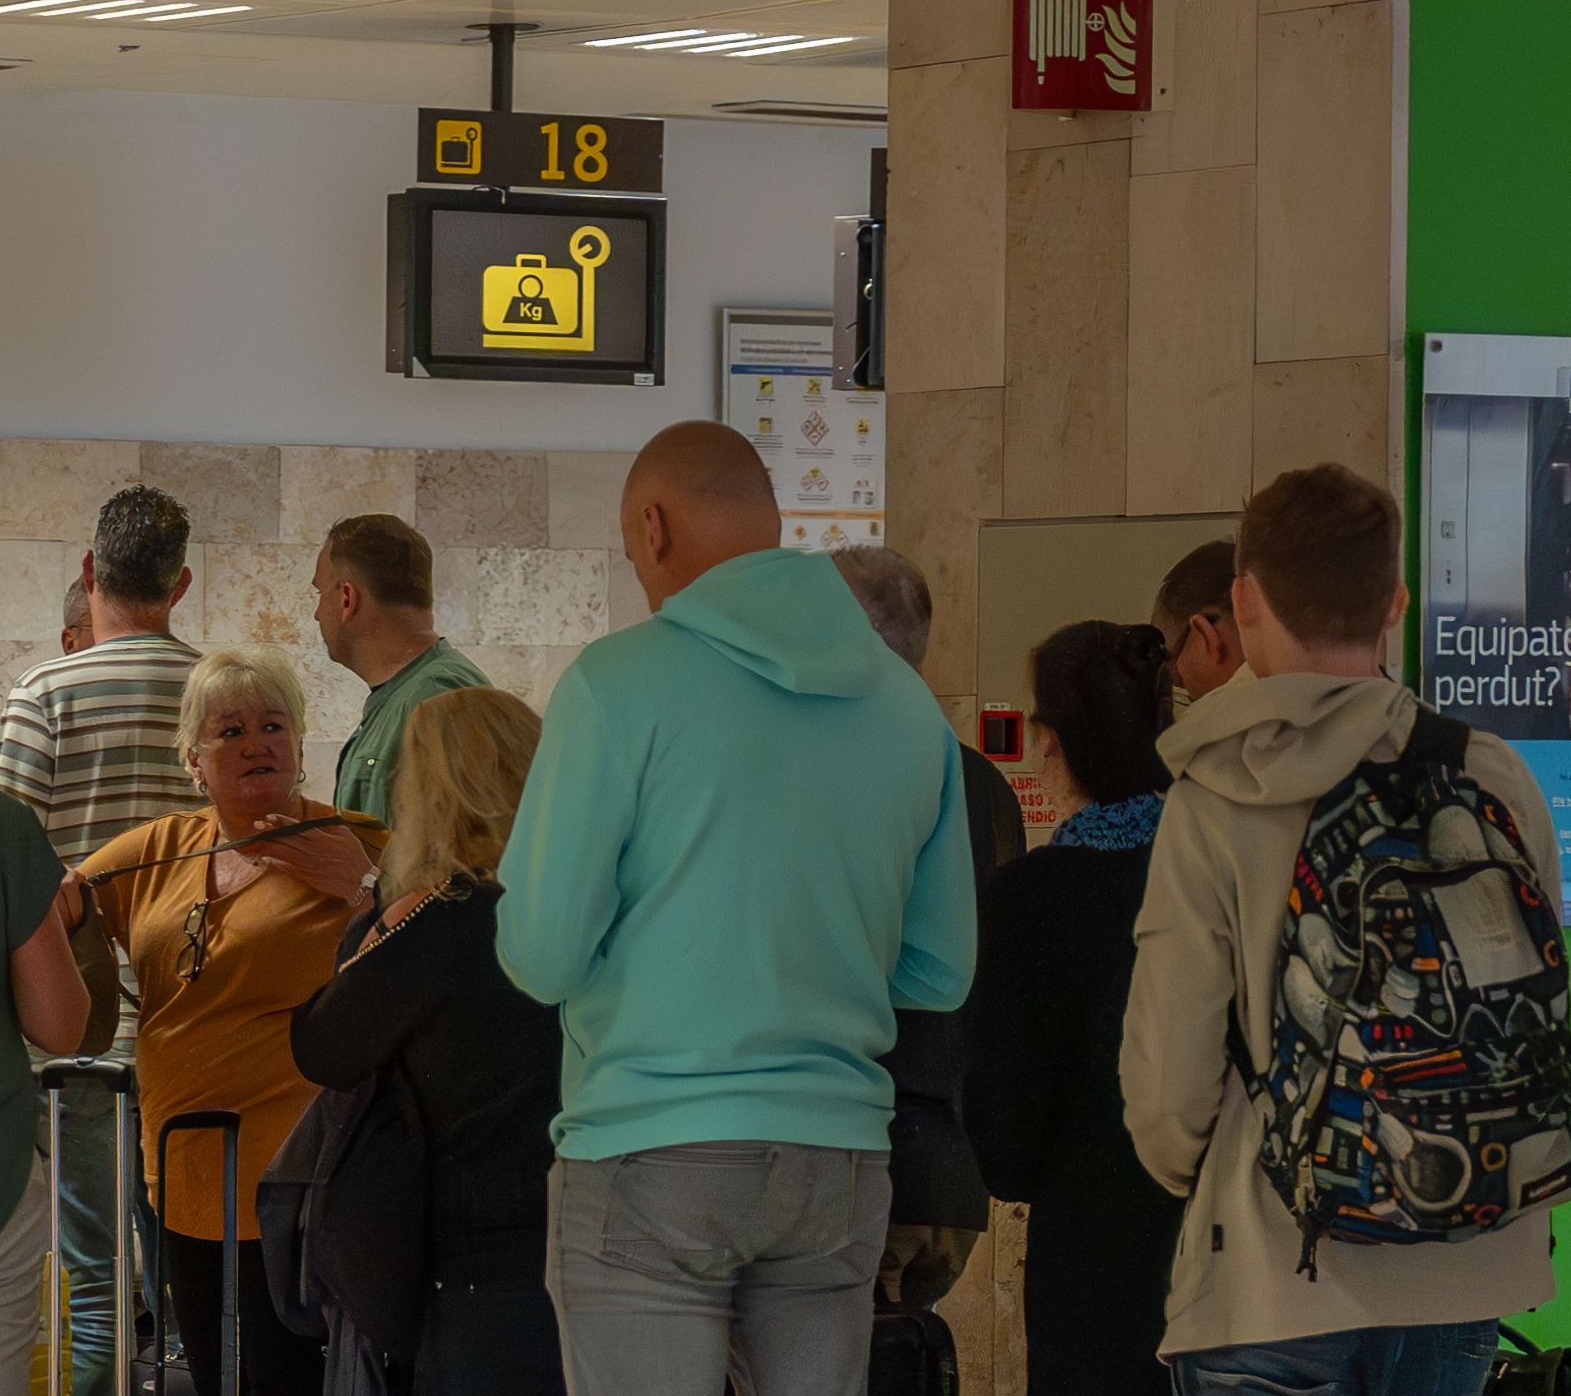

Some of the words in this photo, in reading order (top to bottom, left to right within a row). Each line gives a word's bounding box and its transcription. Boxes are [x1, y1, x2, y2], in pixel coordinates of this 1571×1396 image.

[539, 121, 609, 182] 18
[519, 302, 543, 322] Kg
[1435, 664, 1561, 714] perdut?
[1010, 777, 1040, 790] ABRI
